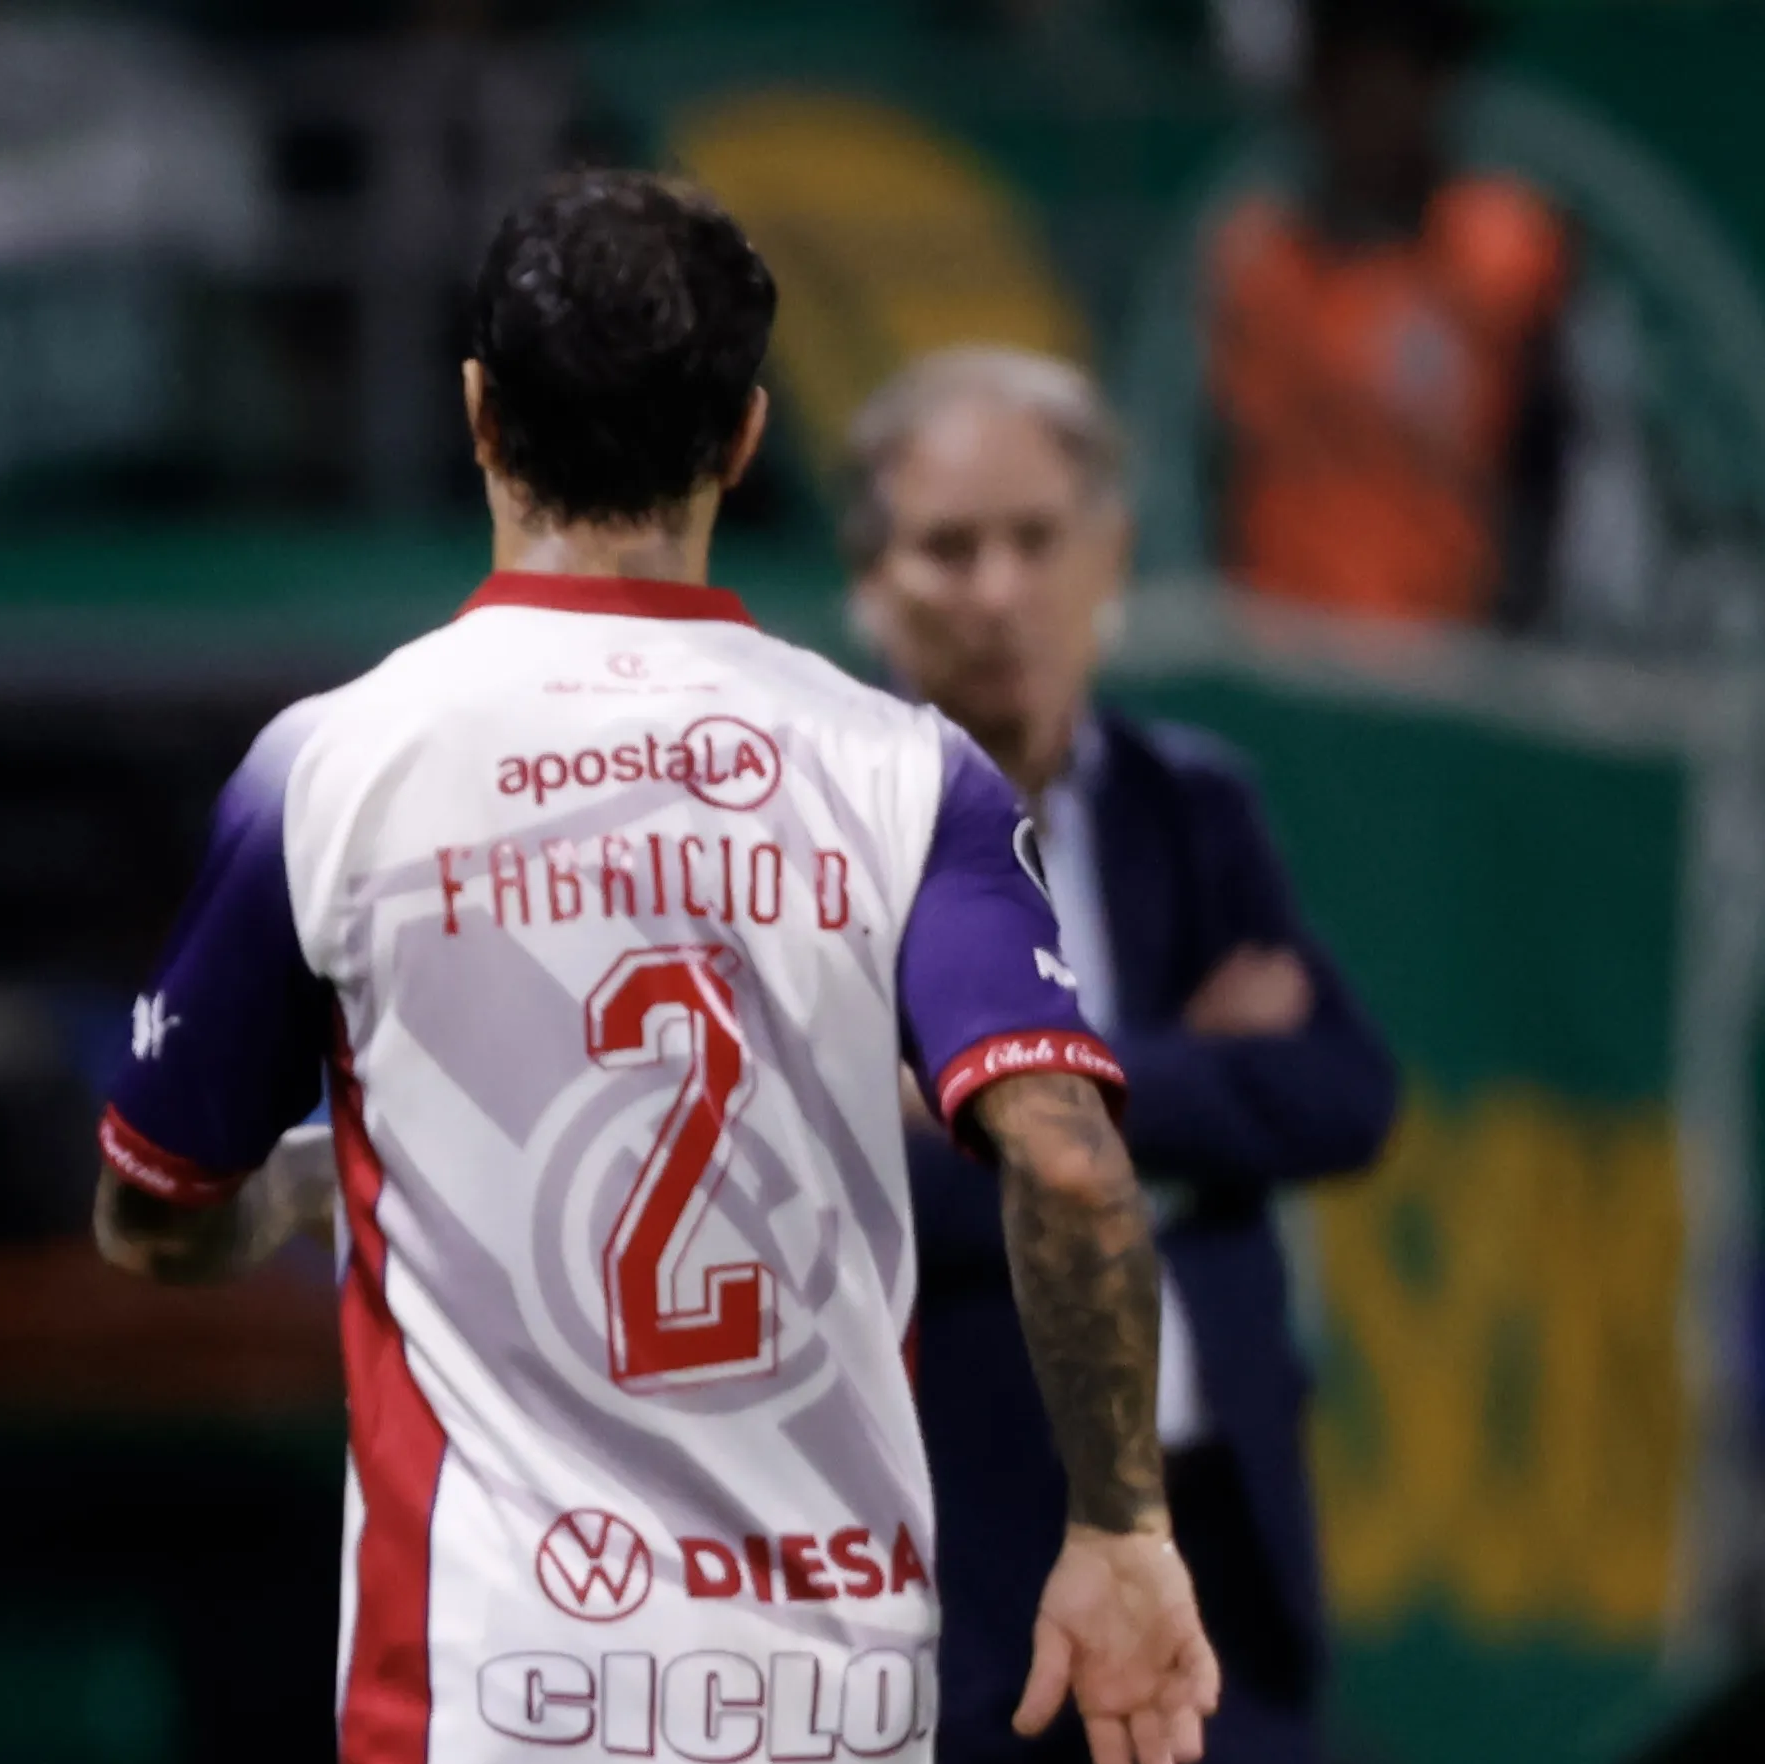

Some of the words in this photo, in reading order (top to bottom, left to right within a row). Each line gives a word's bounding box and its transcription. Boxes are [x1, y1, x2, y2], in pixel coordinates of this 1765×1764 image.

[436, 831, 783, 936] FABRICIO
[585, 943, 777, 1397] 2
[679, 1523, 930, 1602] DIESA
